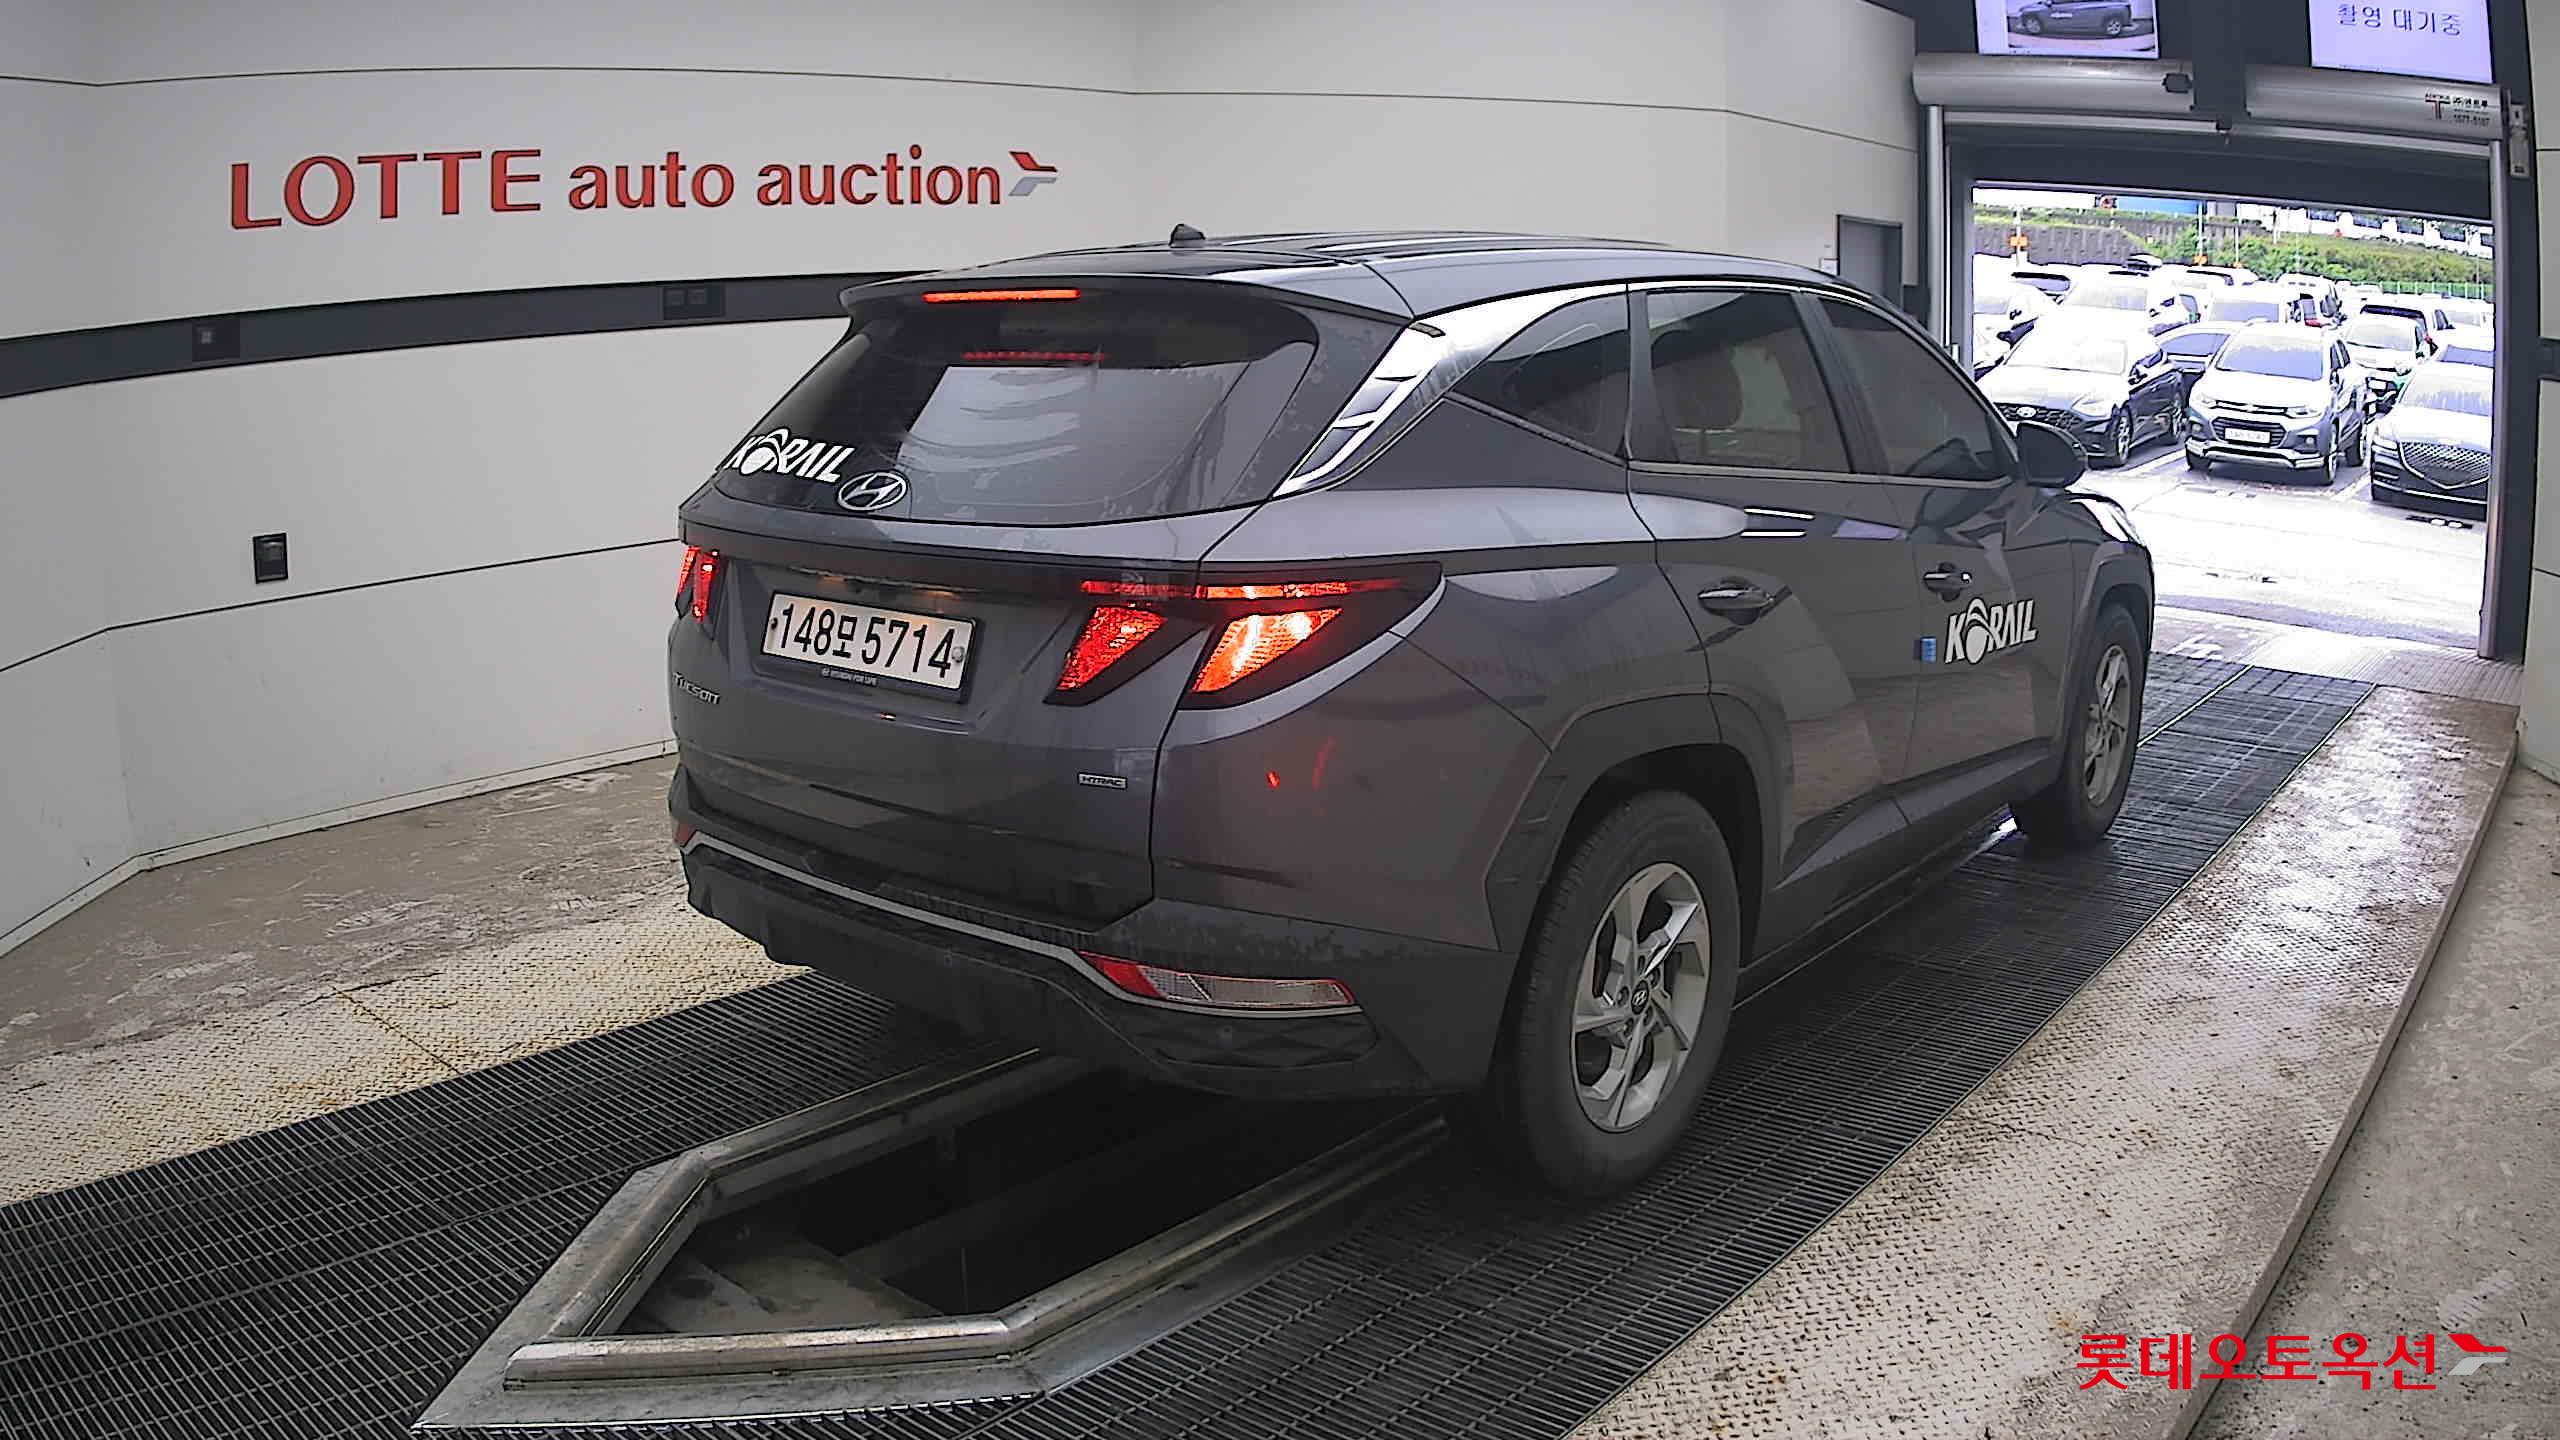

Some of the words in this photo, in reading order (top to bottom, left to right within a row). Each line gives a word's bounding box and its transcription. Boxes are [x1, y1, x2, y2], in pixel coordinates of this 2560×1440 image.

[2393, 9, 2461, 36] 대기중
[230, 148, 542, 230] LOTTE
[568, 151, 735, 209] auto
[757, 145, 1001, 206] auction
[724, 428, 855, 483] KORAIL
[780, 603, 858, 659] 148모
[861, 616, 955, 679] 5714
[1944, 597, 2038, 664] KORAIL
